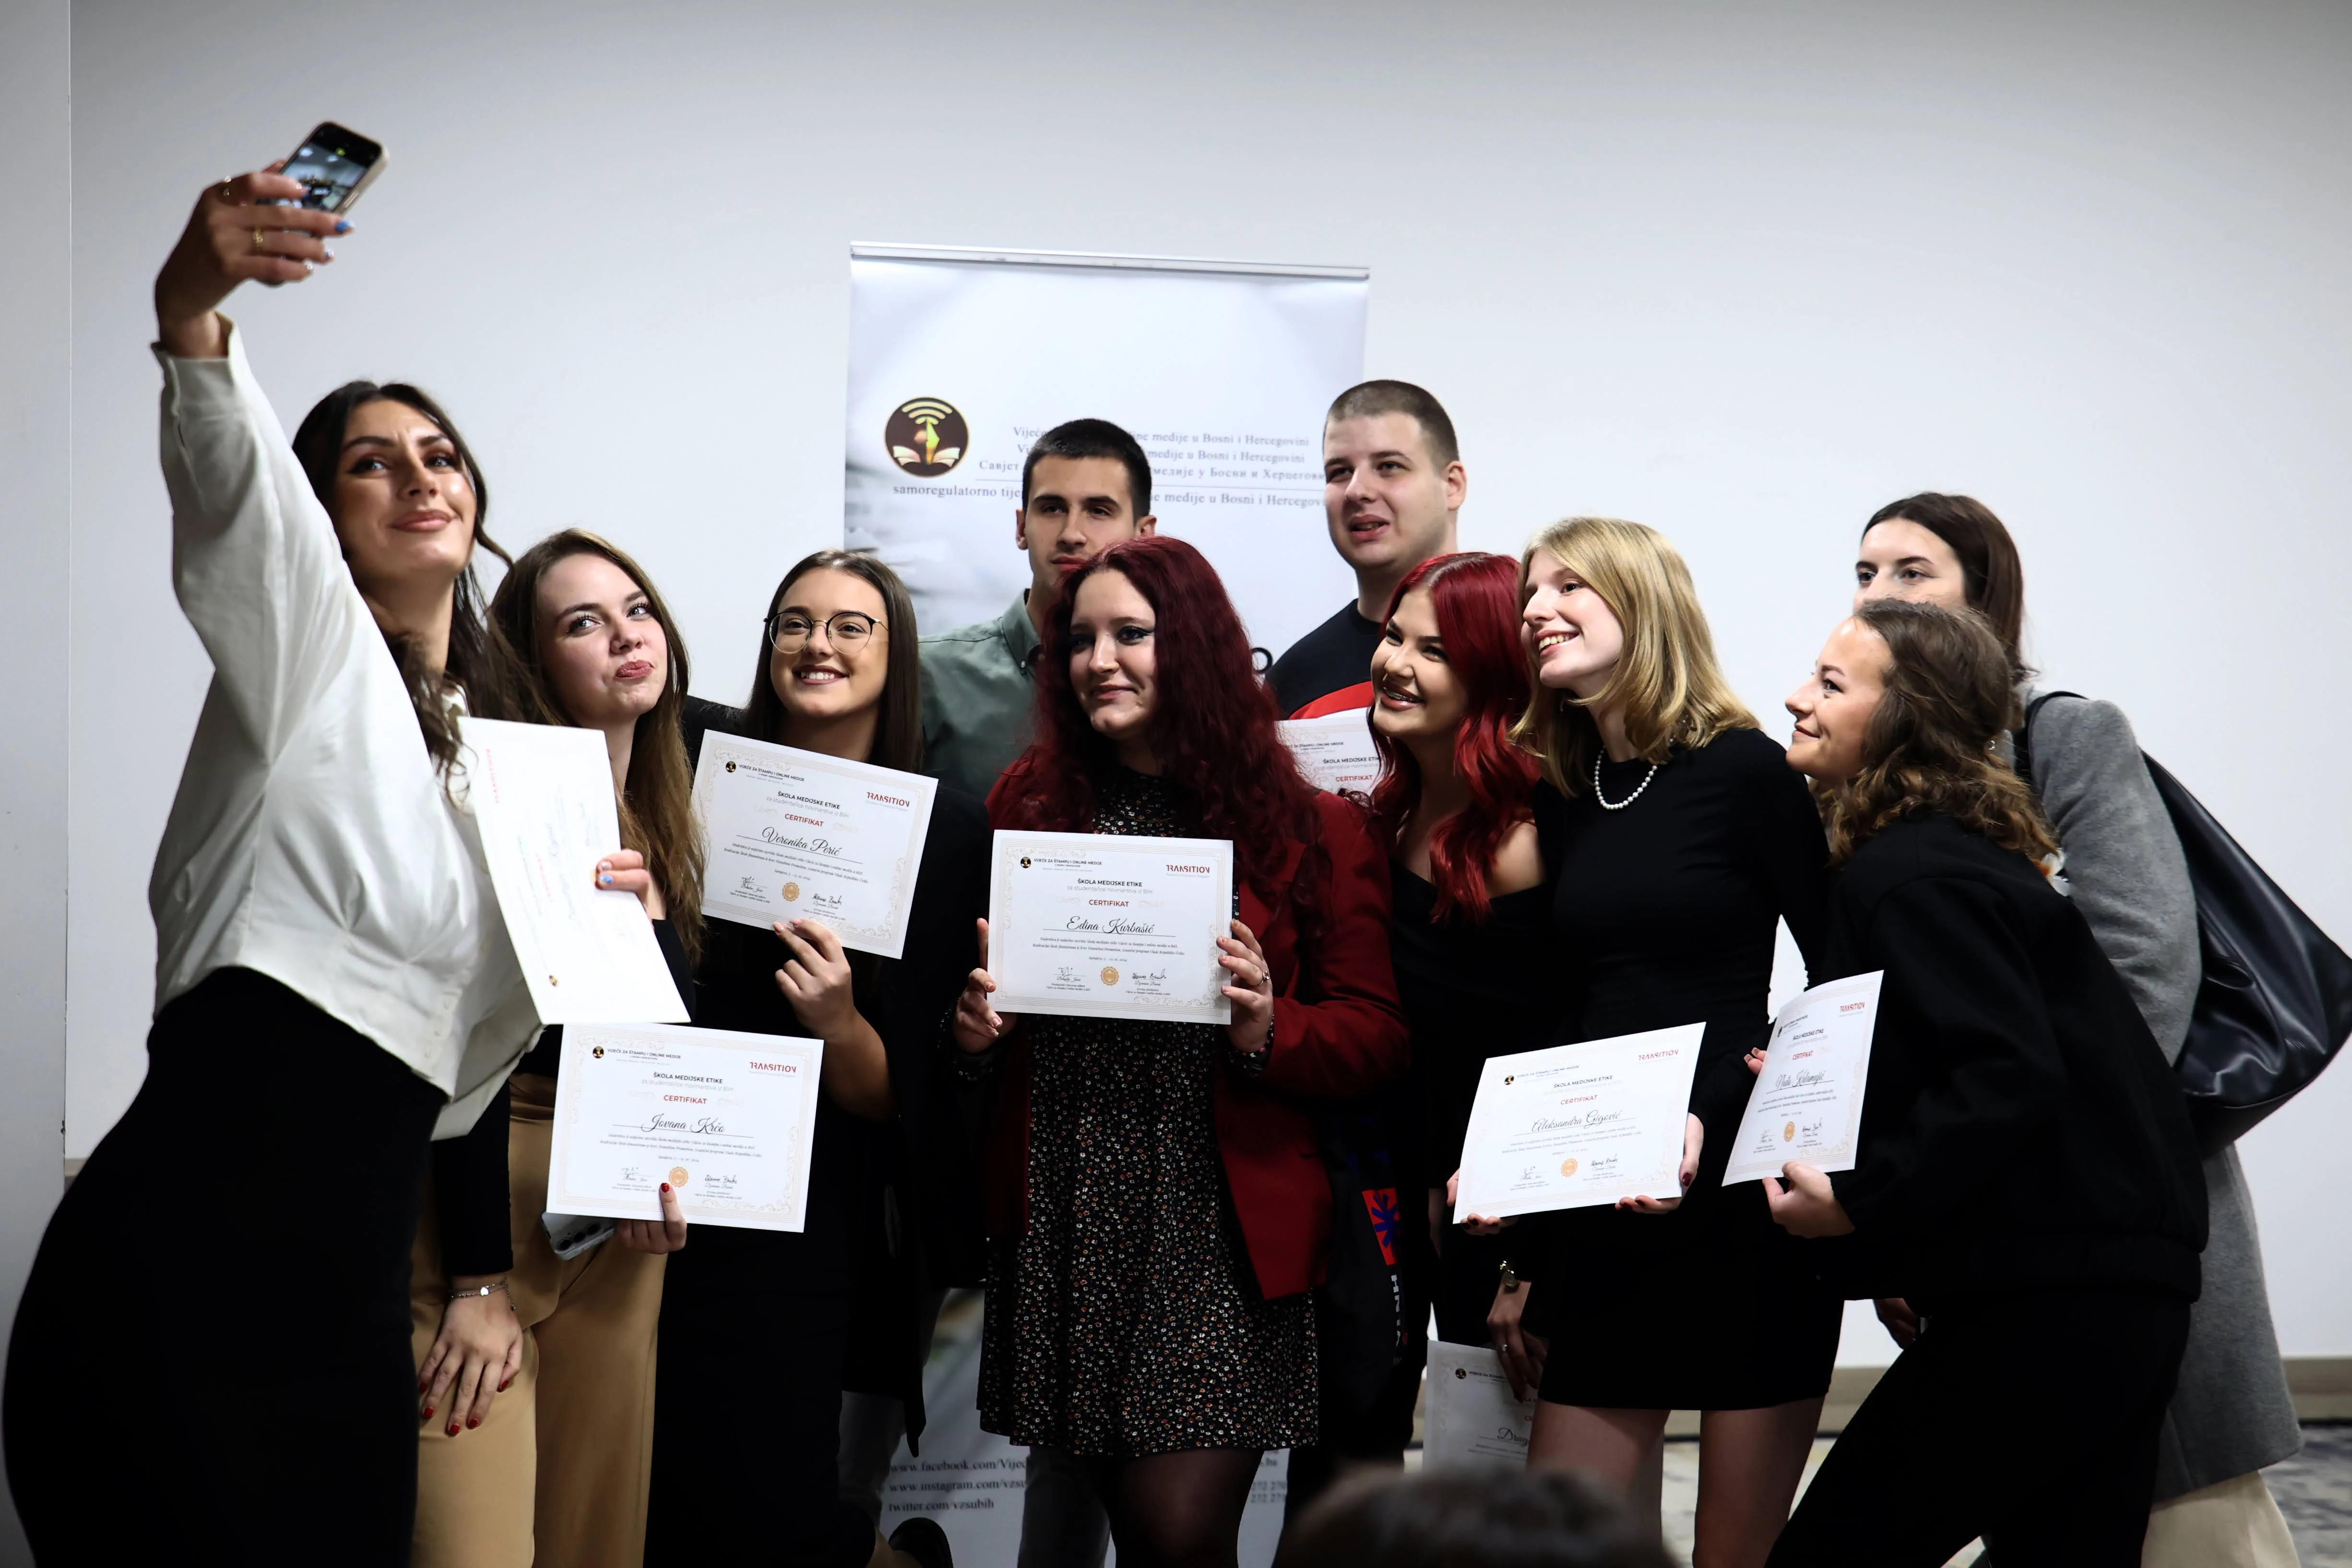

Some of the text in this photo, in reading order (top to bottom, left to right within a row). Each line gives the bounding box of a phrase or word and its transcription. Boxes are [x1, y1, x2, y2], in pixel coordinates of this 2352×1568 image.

[1152, 433, 1189, 444] medije
[1203, 434, 1233, 444] Bosni
[1238, 434, 1241, 444] i
[1246, 435, 1309, 448] Hercegovini
[1148, 450, 1184, 461] medije
[1198, 450, 1228, 460] Bosni
[1233, 451, 1236, 460] i
[1241, 451, 1305, 464] Hercegovini
[979, 461, 1019, 472] Савјет
[1199, 469, 1205, 478] у
[1210, 467, 1246, 478] Босни
[893, 486, 1021, 500] samoregulatorno tije
[1165, 493, 1204, 505] medije
[1221, 493, 1254, 505] Bosni
[1259, 494, 1262, 505] i
[777, 790, 841, 809] ŠKOLA MEDIJSKE ETIKE
[866, 791, 910, 807] TRANSITION
[784, 813, 824, 827] CERTIFIKAT
[762, 827, 808, 850] Veronika
[810, 838, 841, 856] Perić
[1165, 865, 1210, 874] TRANSITION
[1067, 915, 1156, 934] Edina Kurbašić
[749, 1061, 796, 1073] TRANSITION
[663, 1094, 707, 1105] CERTIFIKAT
[1560, 1094, 1598, 1105] CERTIFIKAT
[641, 1113, 726, 1135] Jovana Krčo
[1532, 1117, 1582, 1132] Aleksandra
